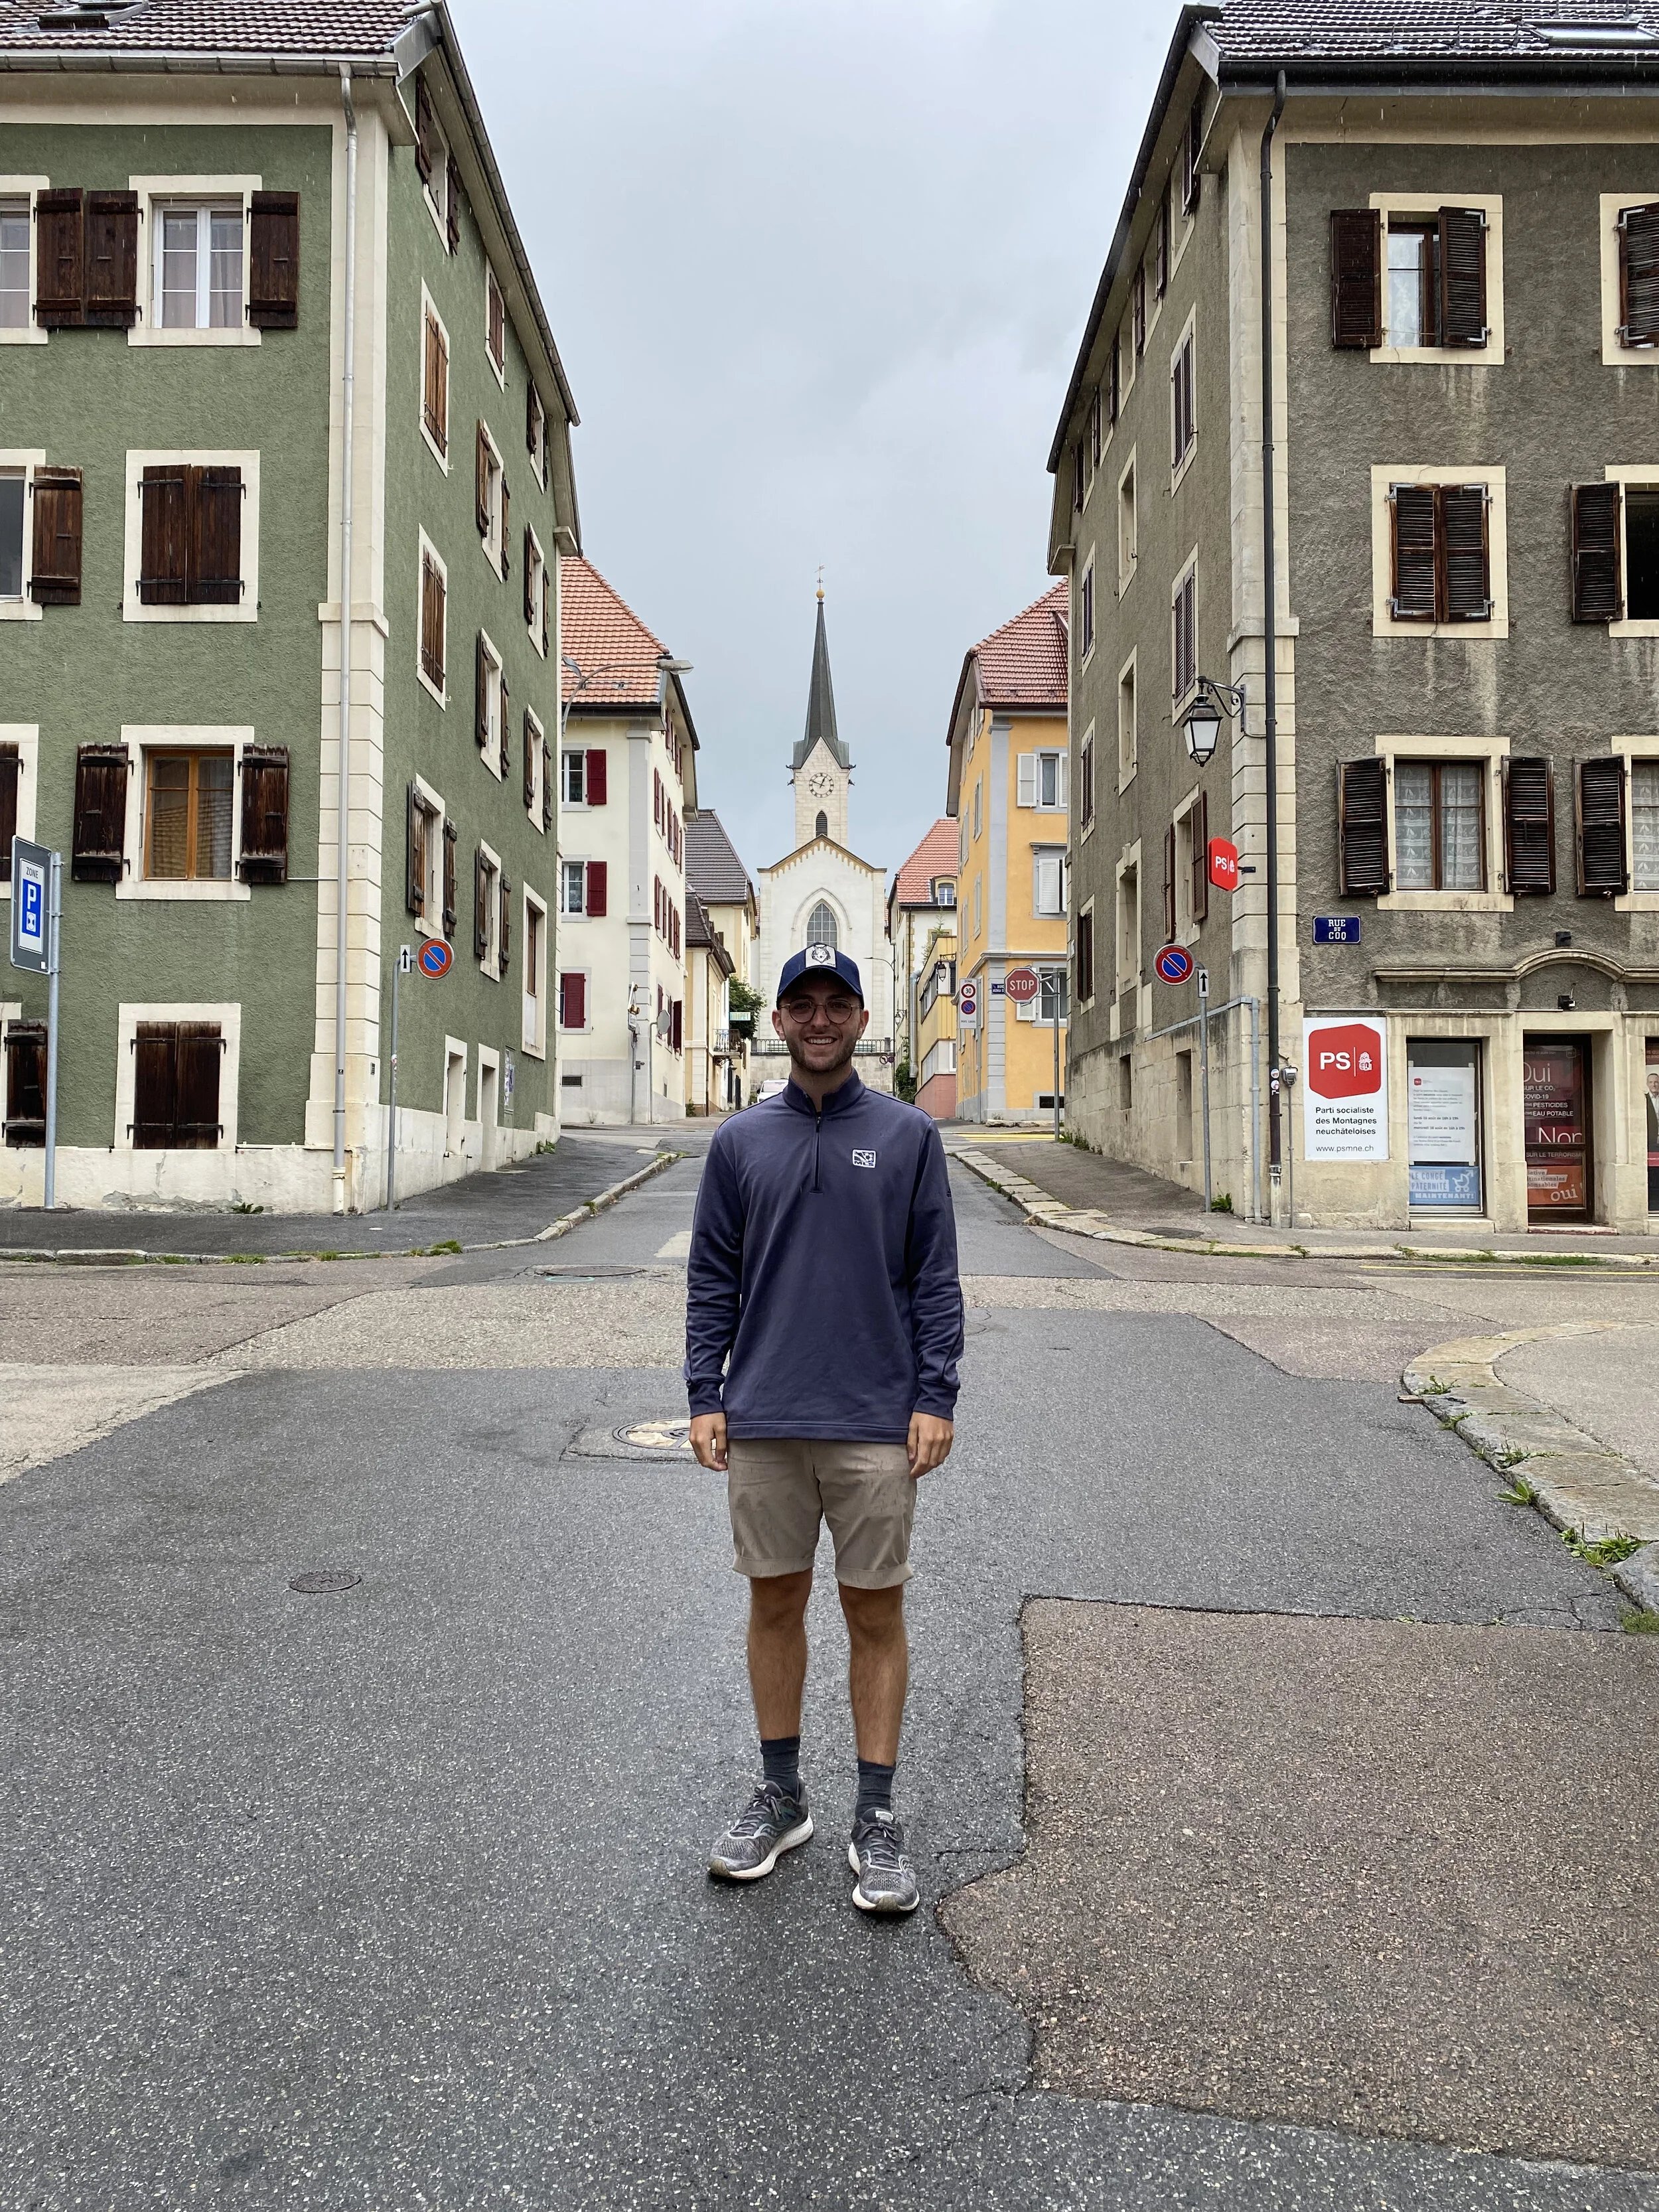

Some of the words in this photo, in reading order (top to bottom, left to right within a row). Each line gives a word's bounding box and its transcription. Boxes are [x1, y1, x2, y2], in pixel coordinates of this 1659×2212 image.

[1215, 855, 1228, 870] PS
[26, 866, 38, 879] ZONE
[27, 883, 36, 910] P
[1329, 932, 1346, 940] COQ
[1009, 980, 1035, 991] STOP
[1320, 1052, 1351, 1070] PS
[1333, 1117, 1377, 1126] Montagnes
[1421, 1171, 1443, 1180] CONGÉ
[1411, 1181, 1447, 1190] PATERNITÉ
